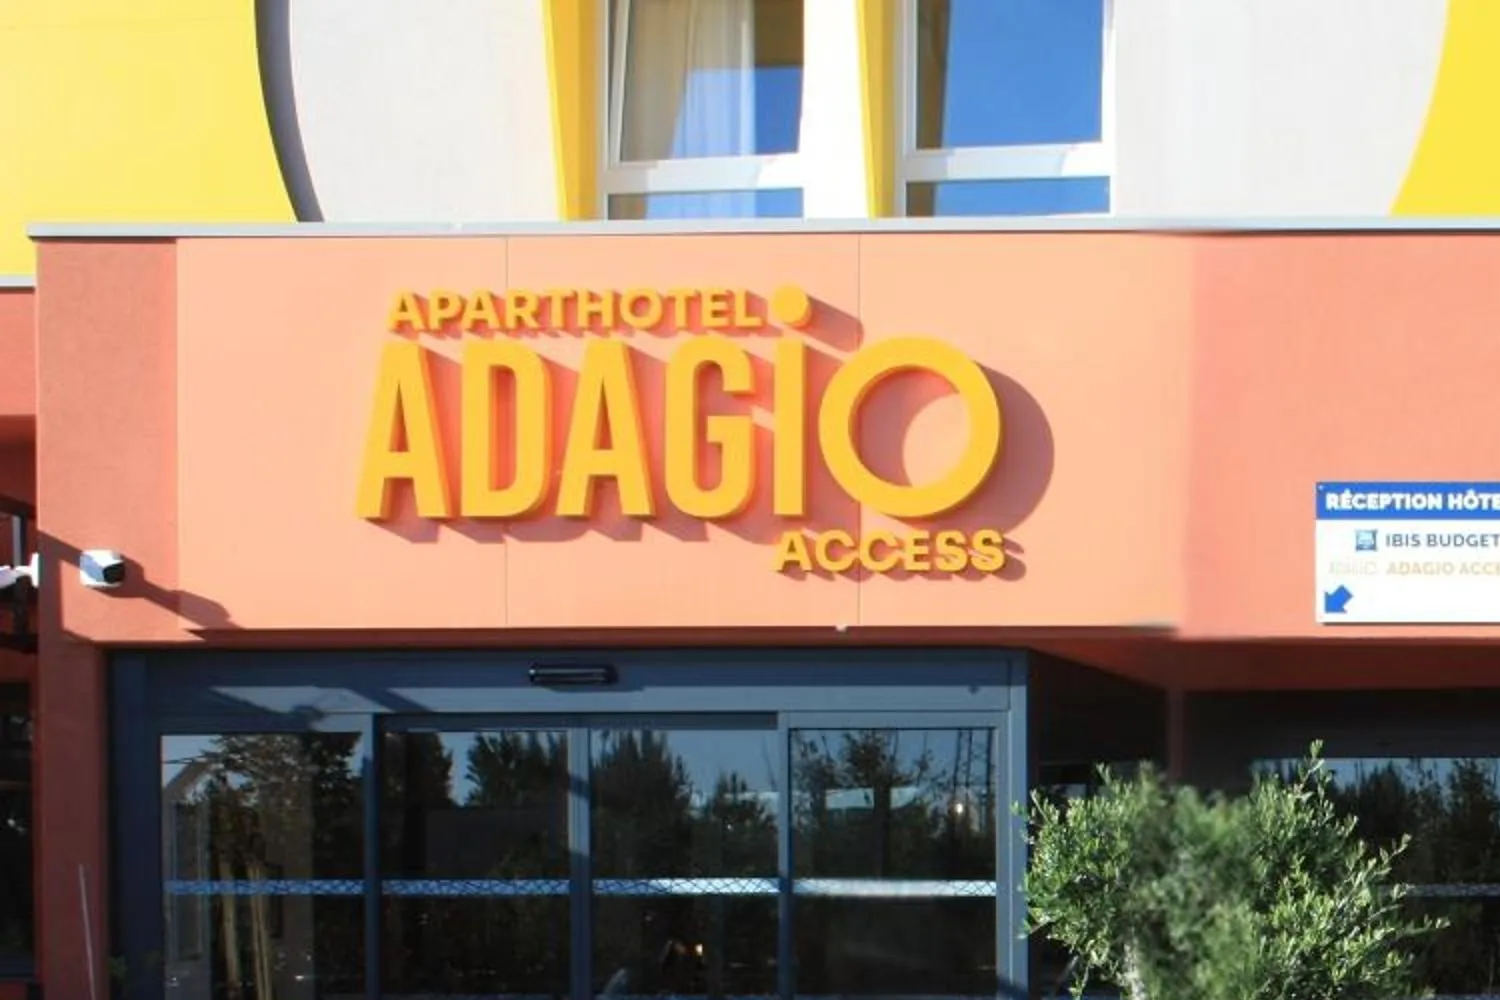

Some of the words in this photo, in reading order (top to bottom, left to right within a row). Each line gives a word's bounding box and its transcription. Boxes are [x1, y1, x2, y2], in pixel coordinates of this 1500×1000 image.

[388, 289, 763, 332] APARTHOTEL
[1325, 489, 1443, 510] RÉCEPTION
[1385, 533, 1422, 547] IBIS
[773, 529, 1006, 573] ACCESS
[1386, 562, 1455, 576] ADAGIO
